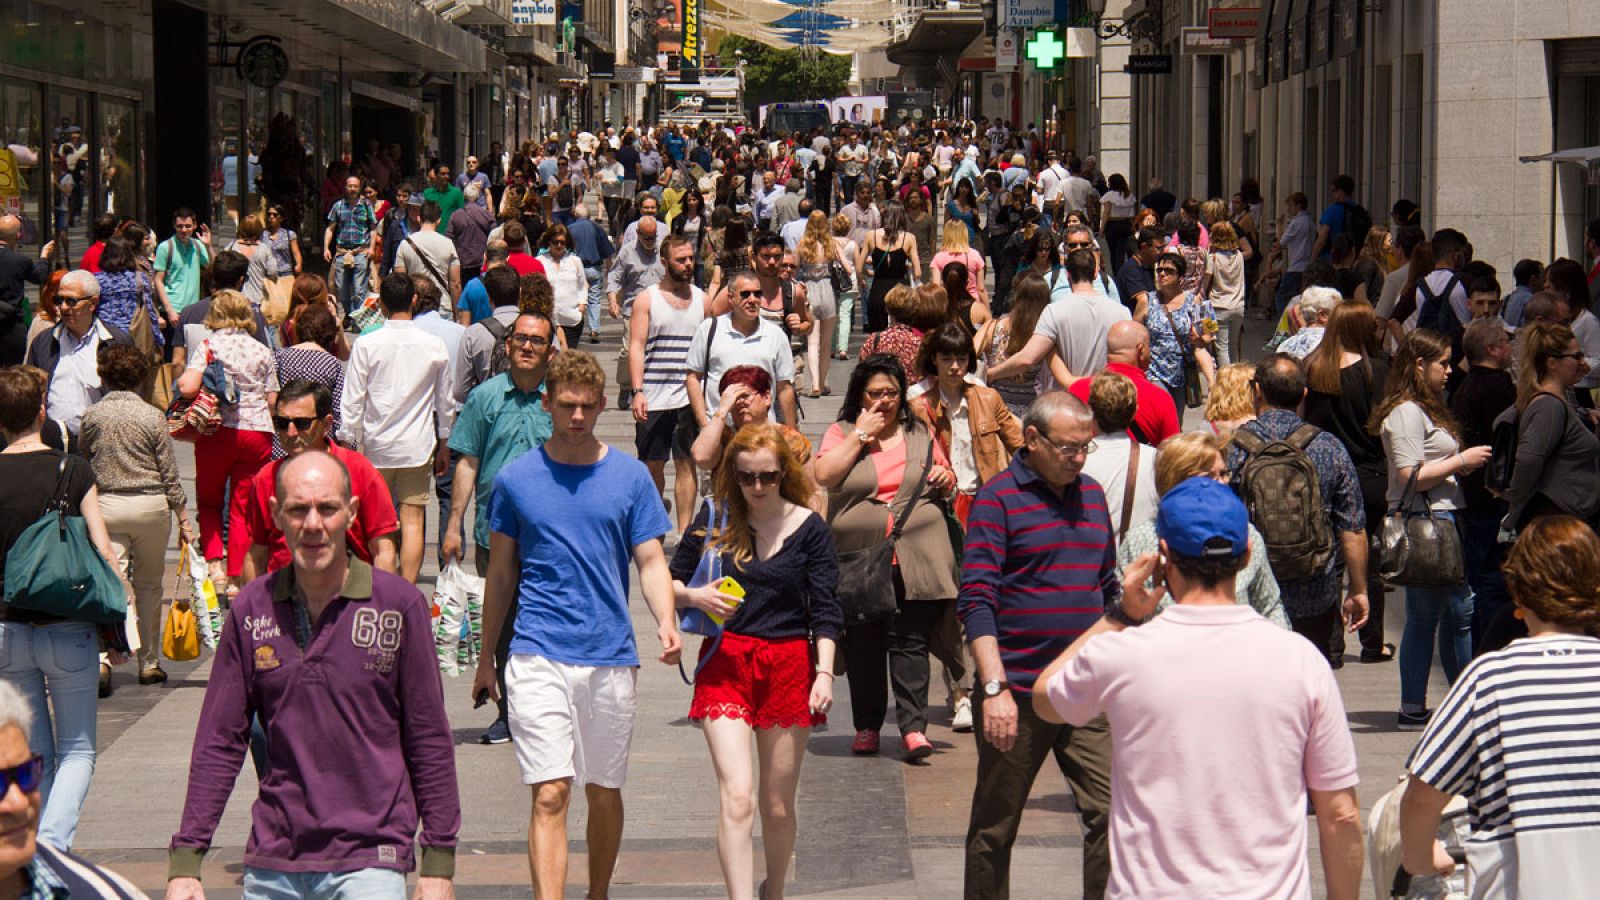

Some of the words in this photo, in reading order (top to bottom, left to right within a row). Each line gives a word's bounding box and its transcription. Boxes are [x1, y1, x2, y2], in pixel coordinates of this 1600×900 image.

[1010, 6, 1052, 16] Danubio
[1010, 16, 1033, 25] Azul
[992, 131, 1004, 145] 78
[252, 624, 281, 641] Creek
[352, 607, 403, 651] 68
